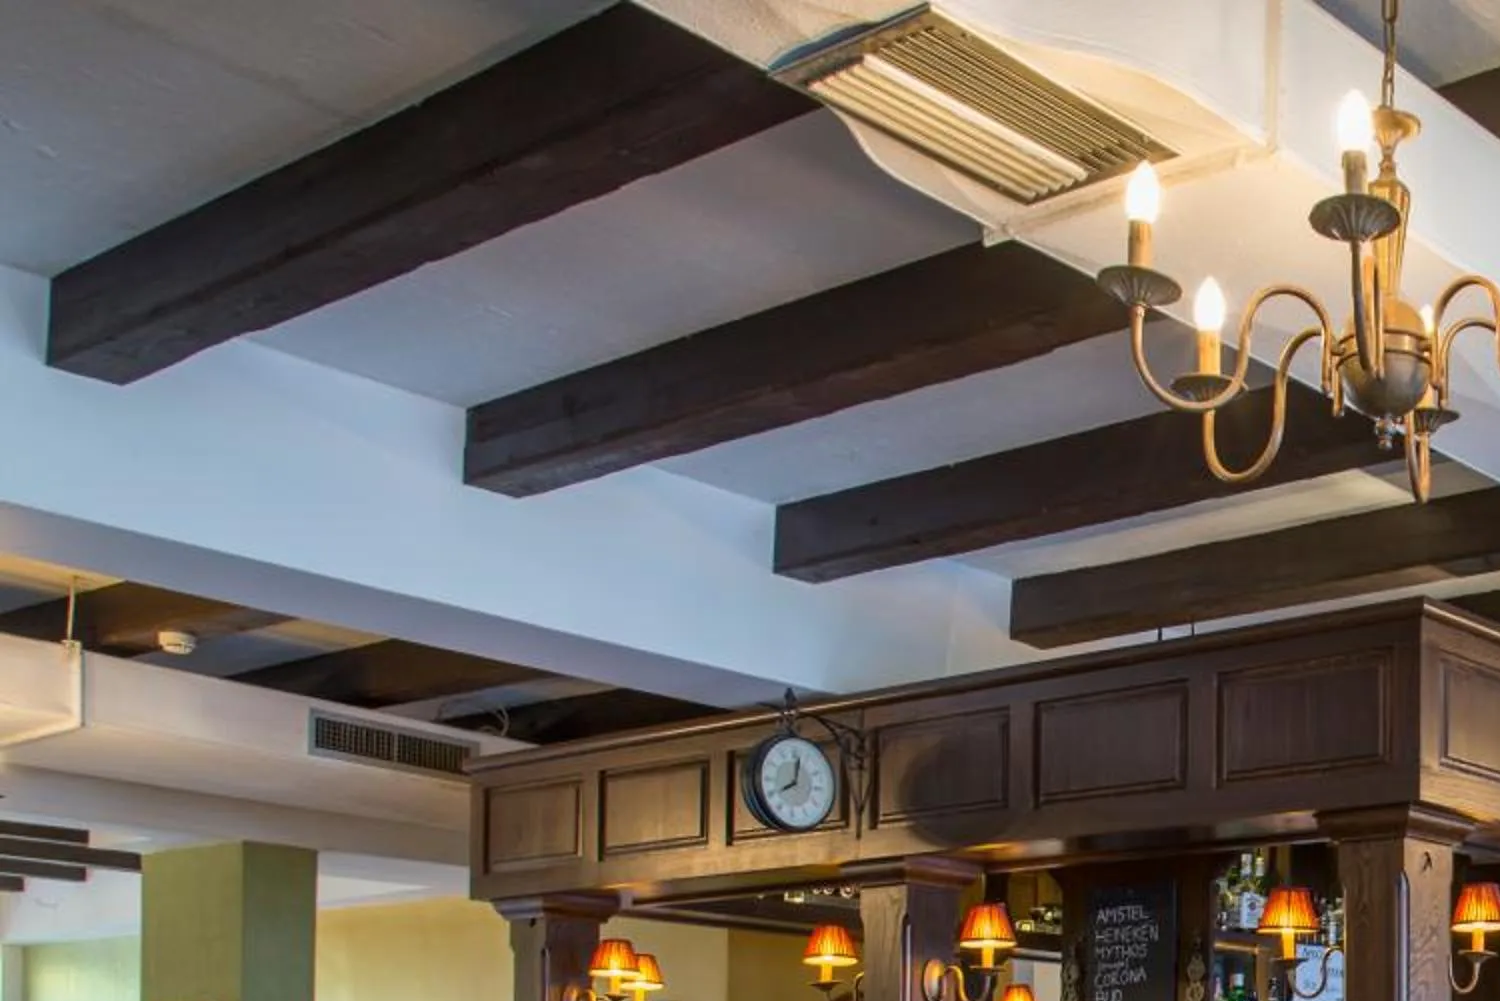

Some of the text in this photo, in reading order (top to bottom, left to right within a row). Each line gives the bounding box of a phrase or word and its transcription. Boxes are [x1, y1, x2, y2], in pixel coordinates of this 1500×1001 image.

[1095, 904, 1150, 924] AMSTEL
[1094, 943, 1148, 960] MYTHOS
[1094, 966, 1147, 988] CORONA
